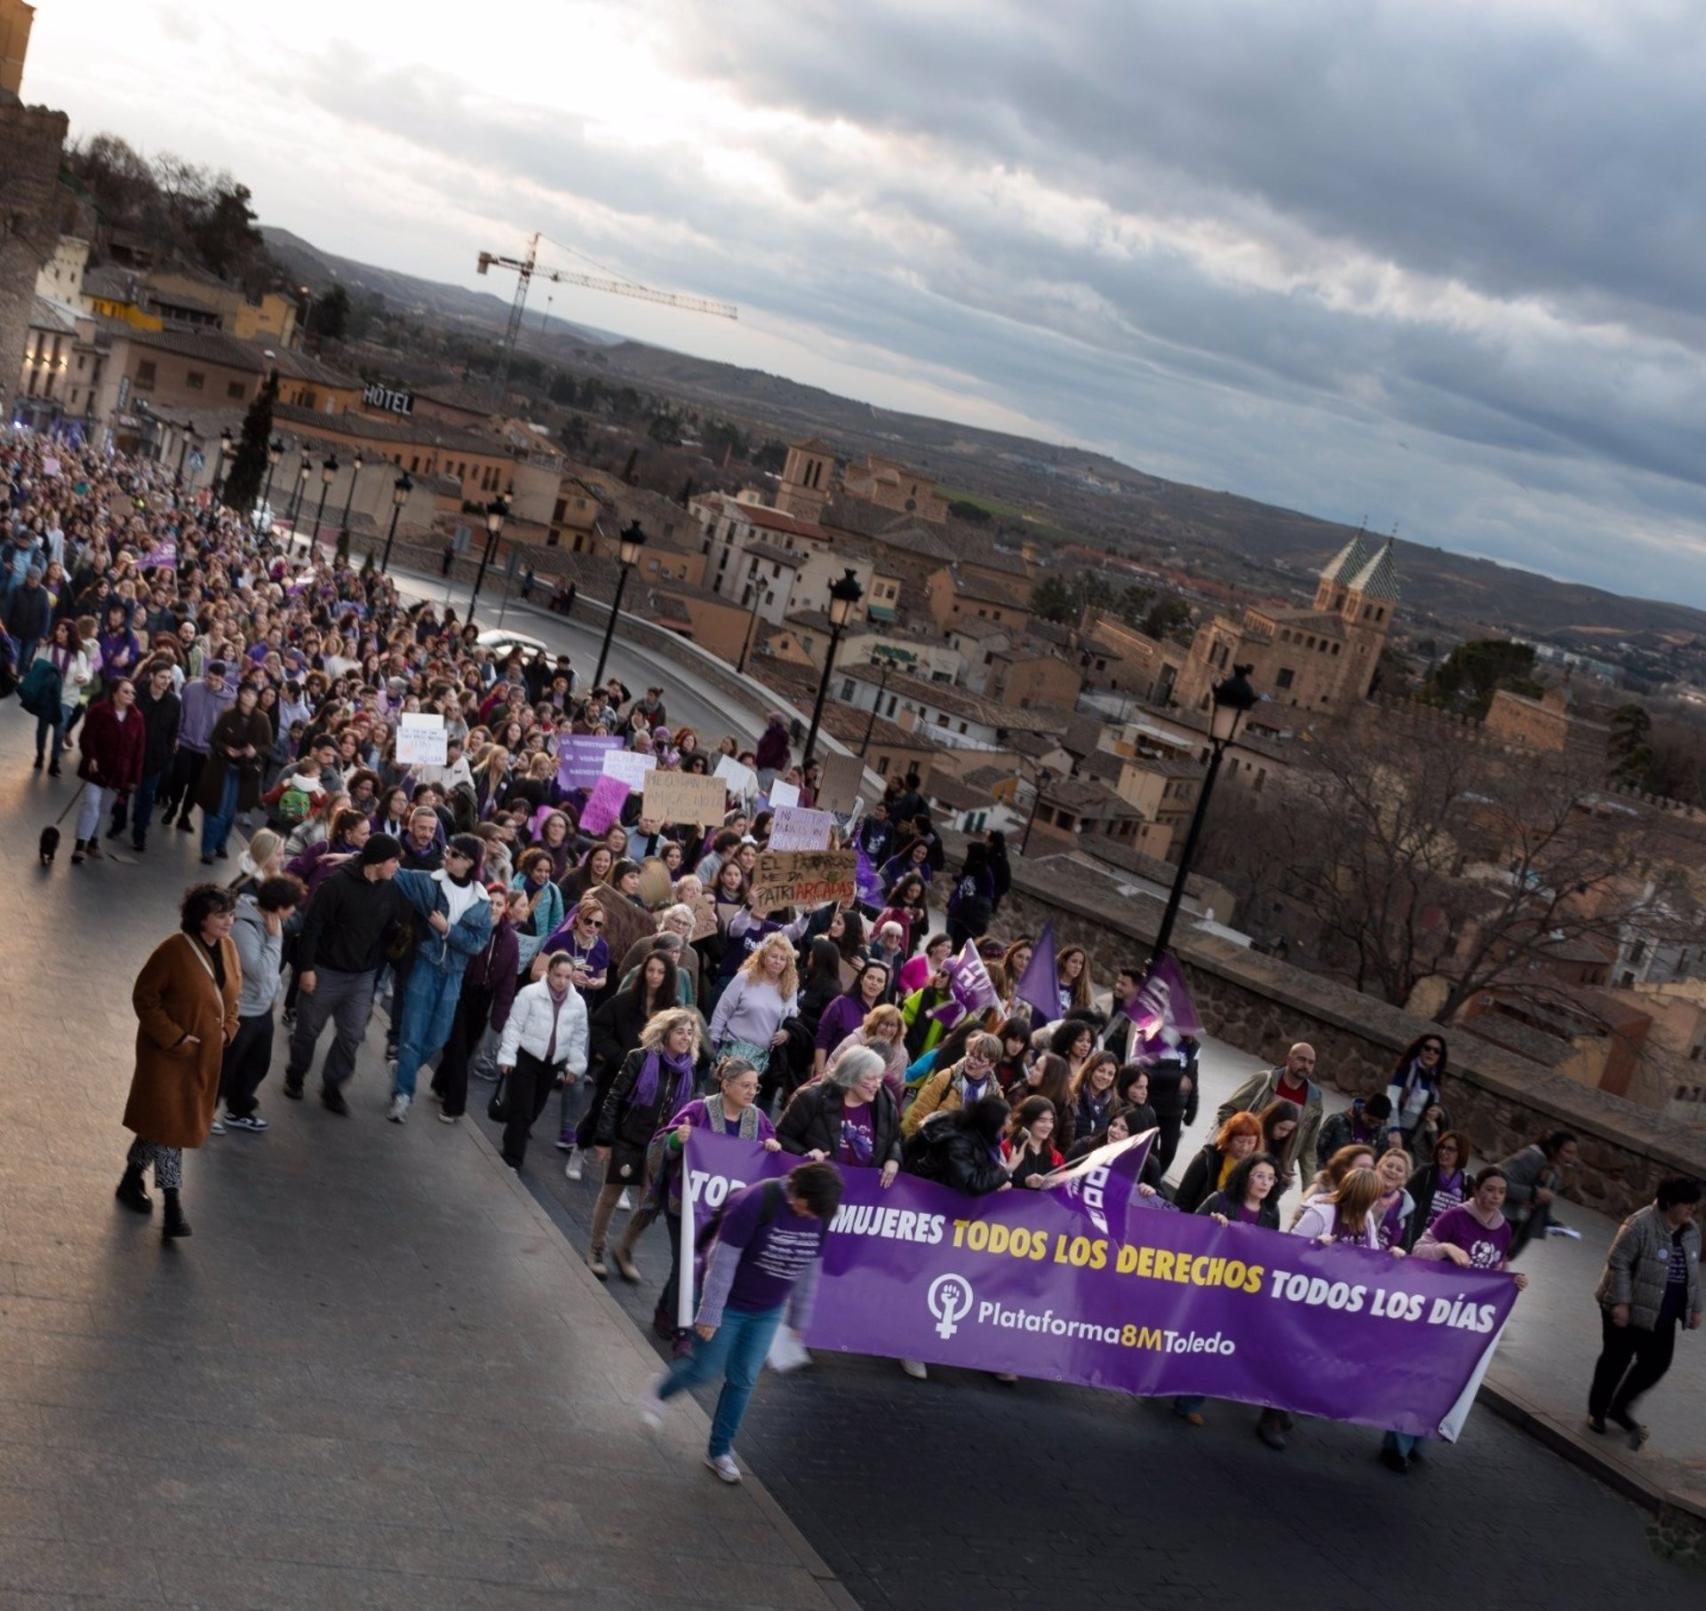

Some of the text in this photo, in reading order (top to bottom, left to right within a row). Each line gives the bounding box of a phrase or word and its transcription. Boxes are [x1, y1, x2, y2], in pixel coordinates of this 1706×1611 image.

[761, 856, 781, 871] EL
[828, 1204, 946, 1245] MUJERES
[953, 1219, 1048, 1261] TODOS
[1054, 1234, 1108, 1270] LOS
[1115, 1244, 1265, 1294] DERECHOS
[1270, 1269, 1368, 1313] TODOS
[1369, 1288, 1426, 1321] LOS
[1427, 1293, 1497, 1334] DÍAS
[977, 1301, 1236, 1355] Plataforma8MToledo
